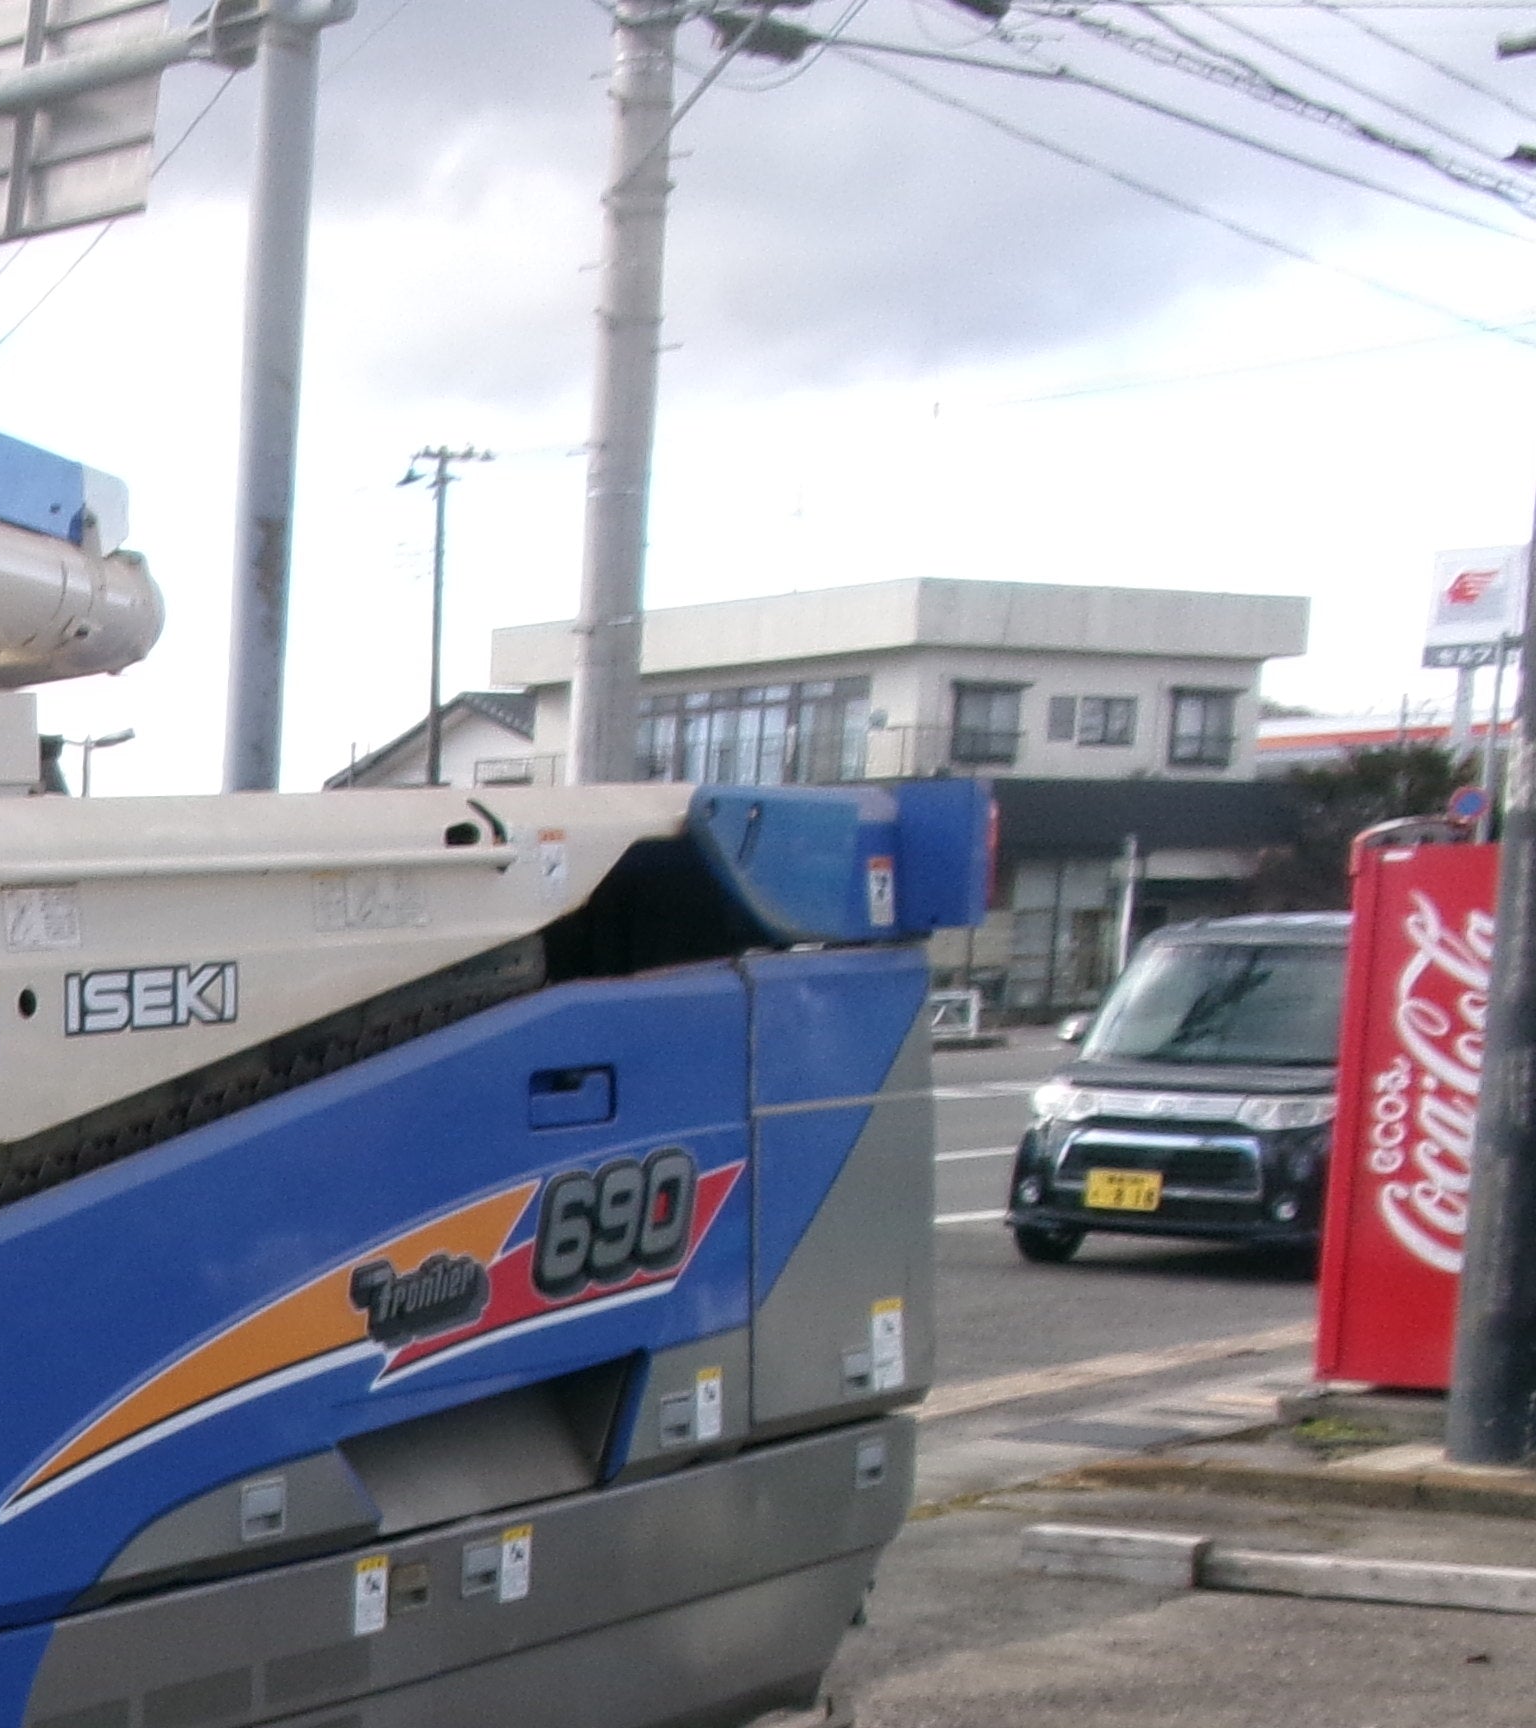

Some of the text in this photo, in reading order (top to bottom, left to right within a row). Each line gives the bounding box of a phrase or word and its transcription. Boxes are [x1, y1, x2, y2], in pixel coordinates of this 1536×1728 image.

[64, 961, 238, 1037] ISEKI
[537, 1151, 695, 1291] 690
[354, 1260, 481, 1328] Frontier
